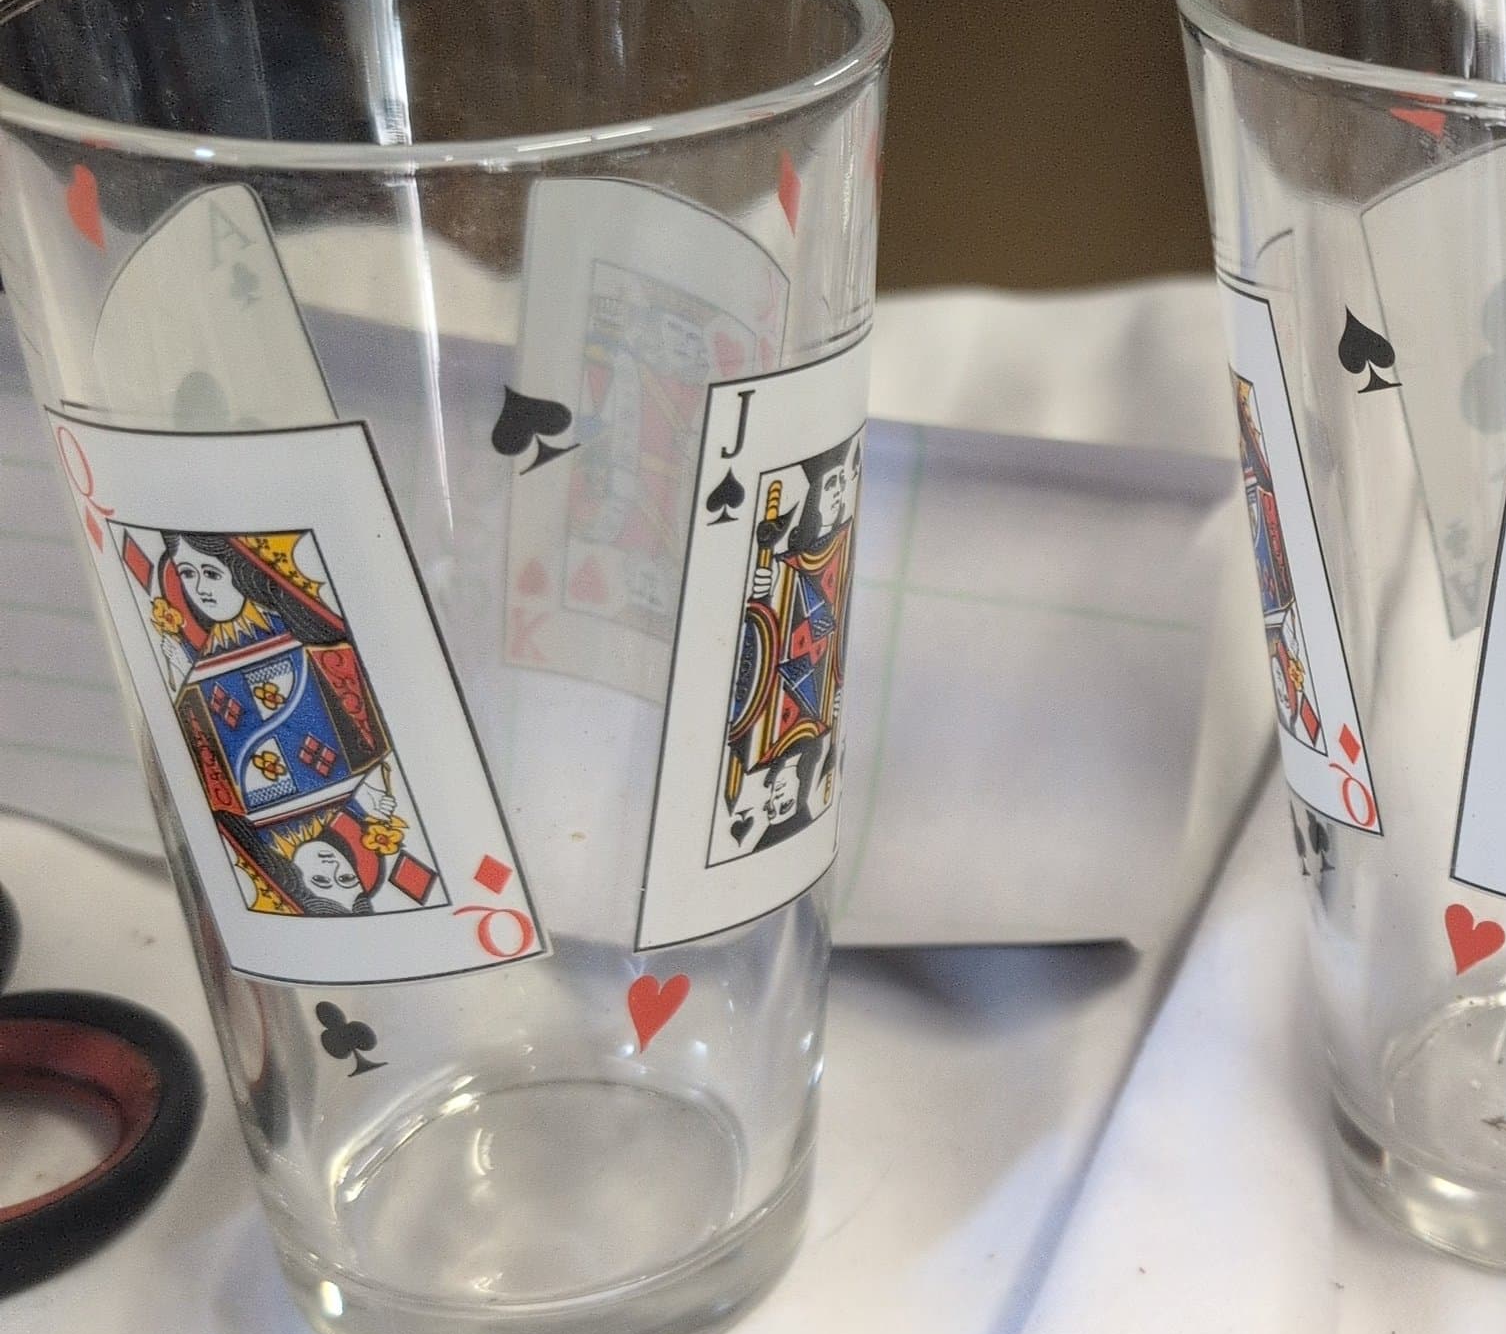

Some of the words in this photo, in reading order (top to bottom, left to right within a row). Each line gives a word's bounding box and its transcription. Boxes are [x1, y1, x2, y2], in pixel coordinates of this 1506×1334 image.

[721, 390, 756, 460] J
[57, 425, 114, 517] Q
[1328, 763, 1376, 829] Q
[453, 904, 535, 959] Q
